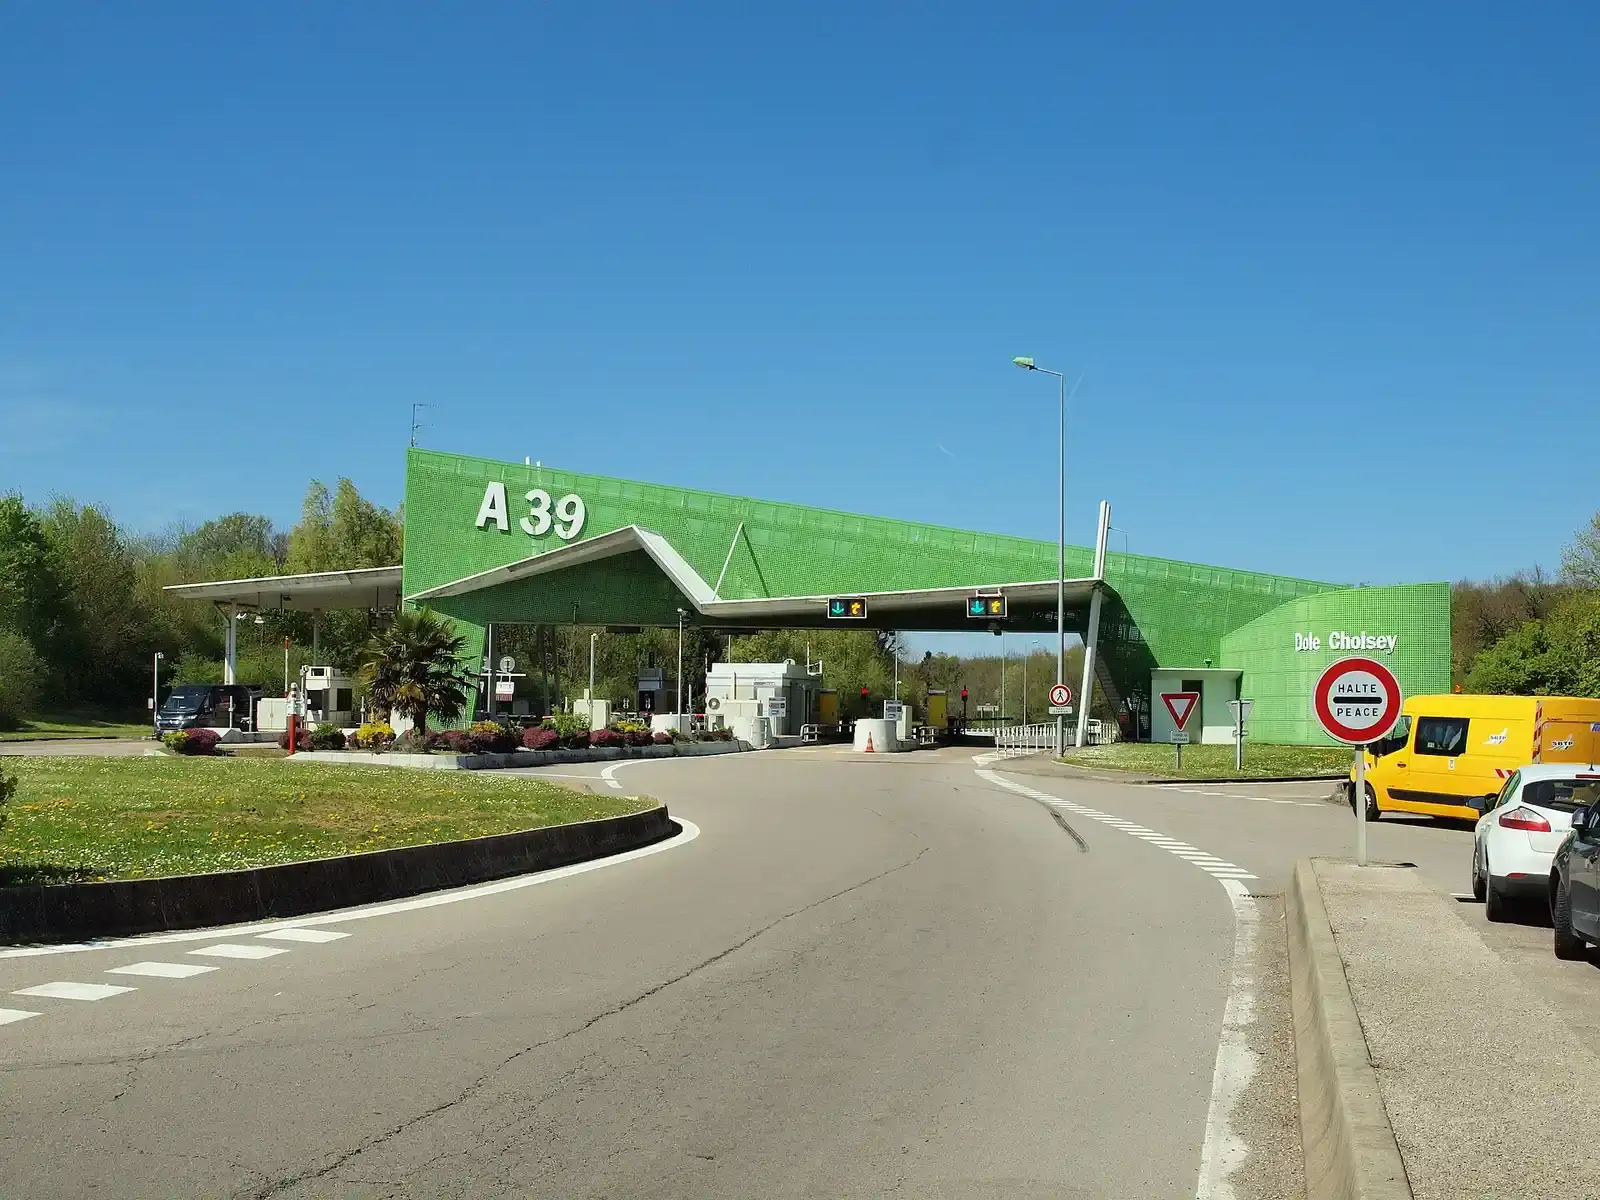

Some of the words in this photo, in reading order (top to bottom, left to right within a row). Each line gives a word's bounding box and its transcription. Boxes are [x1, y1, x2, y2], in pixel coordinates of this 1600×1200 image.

[475, 481, 509, 531] A
[520, 488, 586, 540] 39
[1294, 631, 1321, 652] Dole
[1328, 631, 1398, 655] Choisey
[1338, 683, 1377, 694] HALTE
[1337, 707, 1379, 717] PEACE
